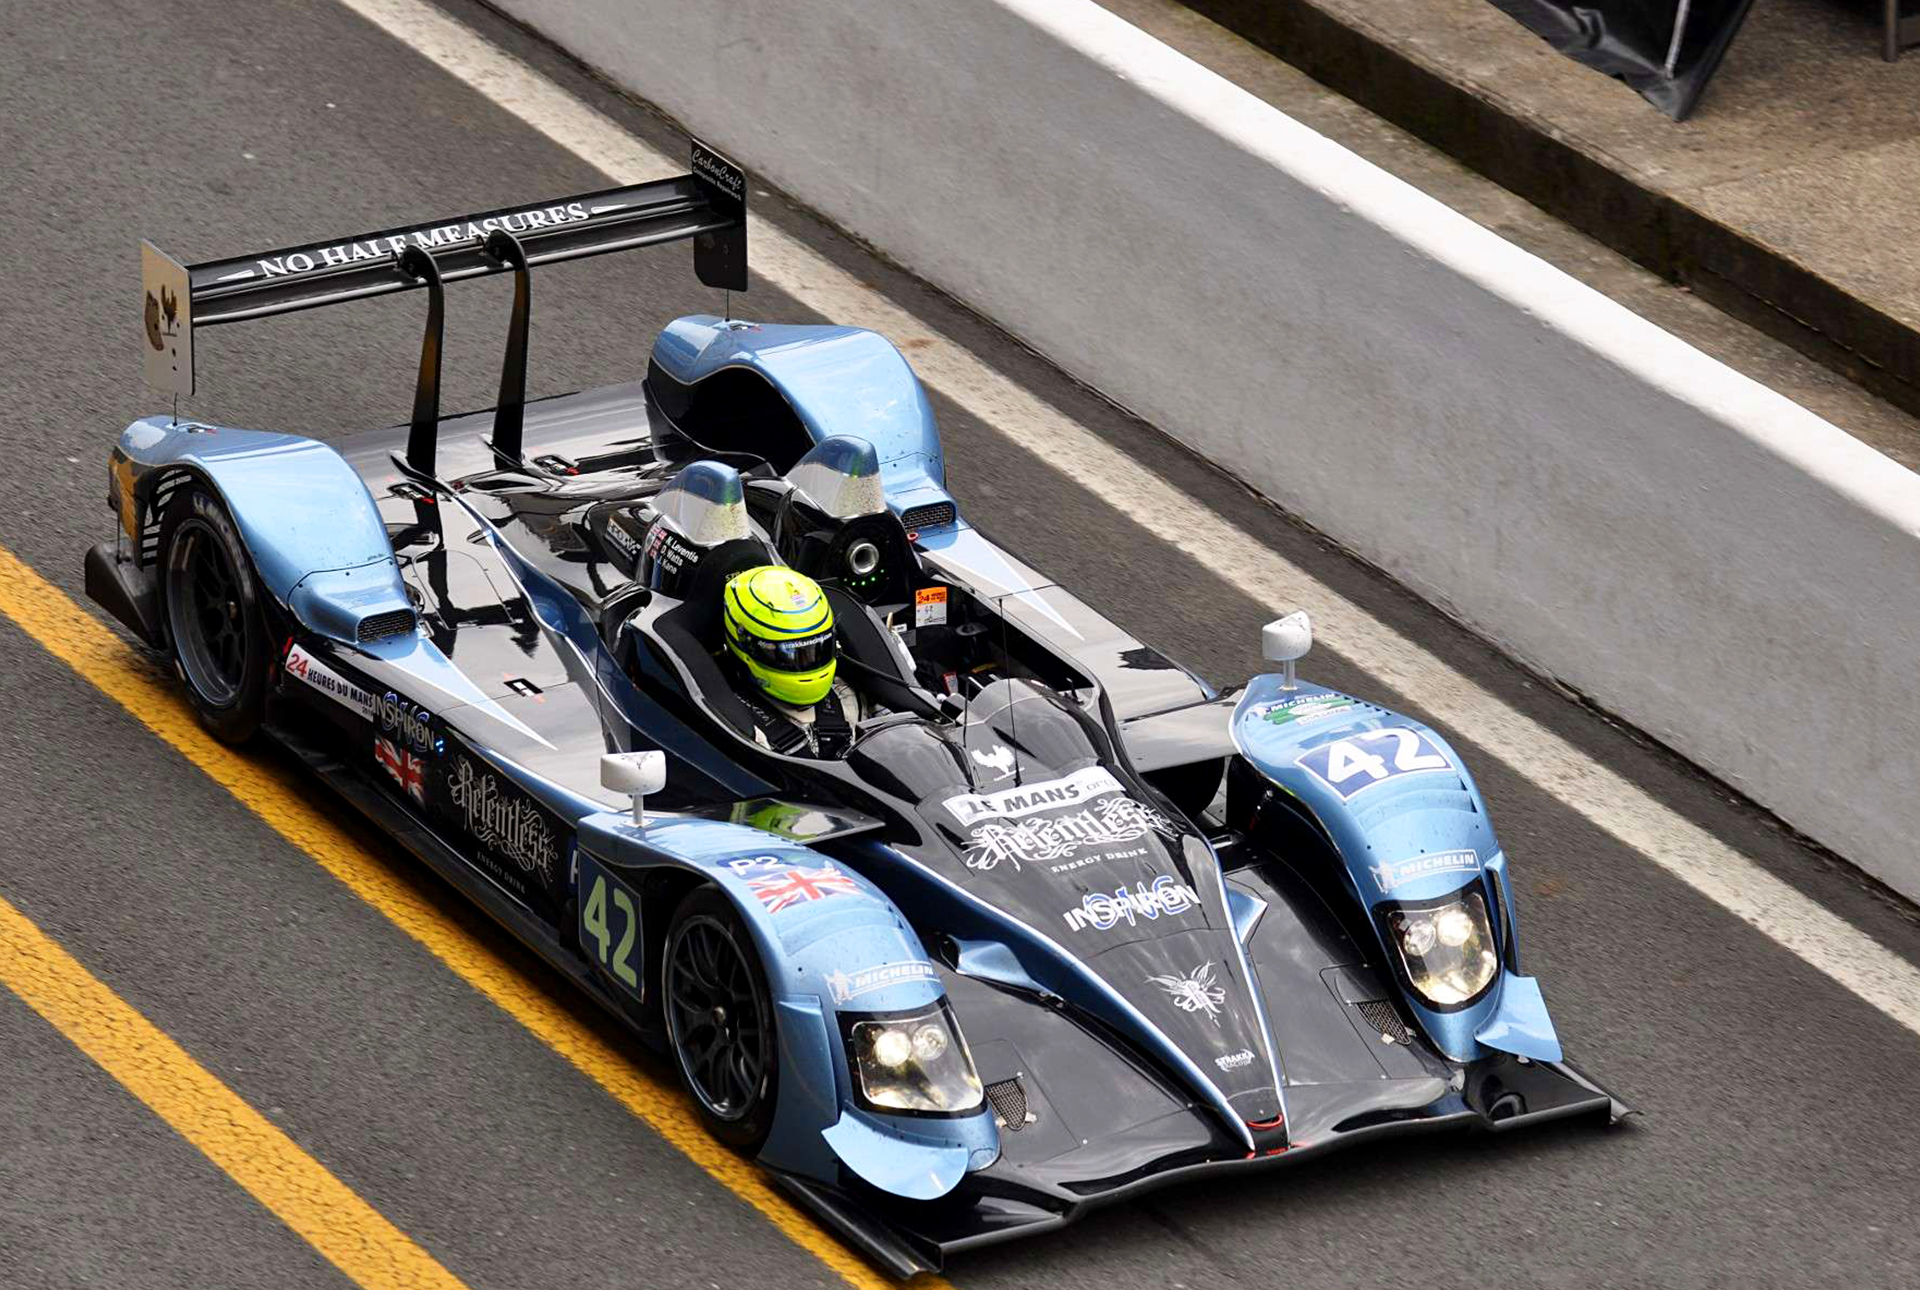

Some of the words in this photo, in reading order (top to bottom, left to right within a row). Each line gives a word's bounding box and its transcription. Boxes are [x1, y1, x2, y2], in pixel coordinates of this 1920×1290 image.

[256, 252, 315, 278] NO
[317, 234, 408, 267] HALF
[412, 202, 590, 250] MEASURES
[666, 547, 684, 567] Watts
[671, 539, 700, 564] Leventis
[286, 653, 309, 678] 24
[307, 668, 336, 692] HEURES
[336, 682, 349, 698] DU
[350, 687, 373, 709] MANS
[1270, 693, 1336, 712] MICHELIN
[373, 693, 435, 750] INSPIRON
[1327, 727, 1447, 783] 42
[1003, 784, 1080, 813] MANS
[961, 797, 1178, 872] Relentless
[729, 856, 785, 875] P2
[1051, 854, 1101, 873] ENERGY
[1105, 847, 1148, 860] DRINK
[1400, 853, 1475, 875] MICHELIN
[583, 875, 637, 988] 42
[855, 964, 934, 988] MICHELIN
